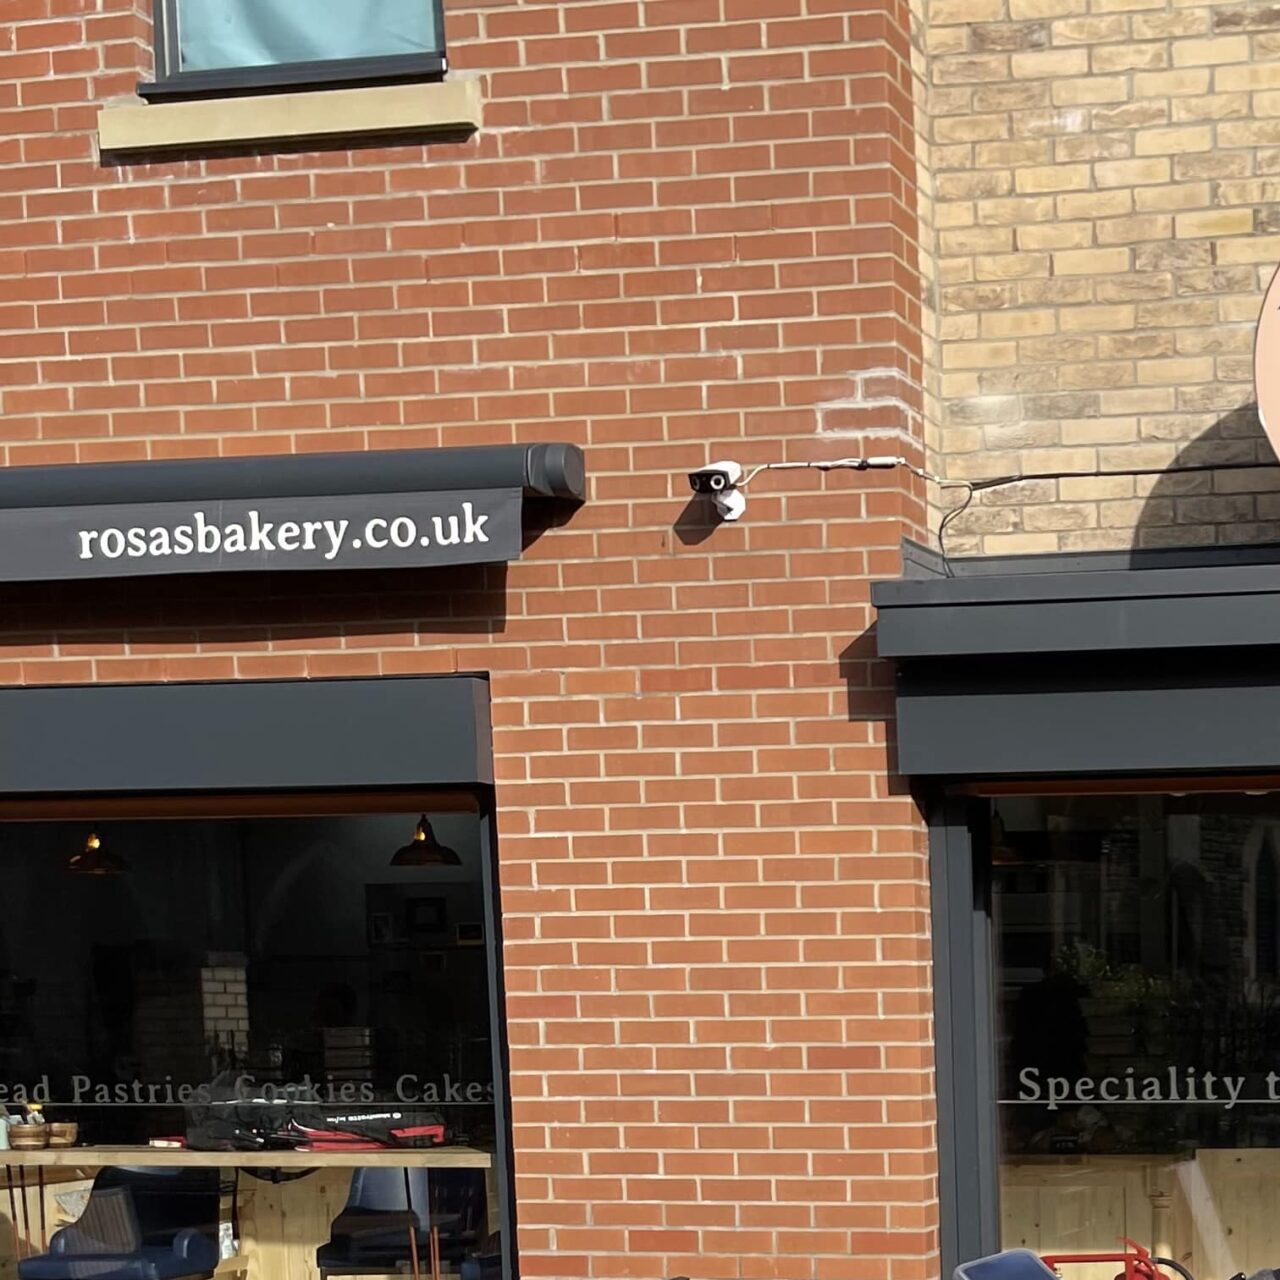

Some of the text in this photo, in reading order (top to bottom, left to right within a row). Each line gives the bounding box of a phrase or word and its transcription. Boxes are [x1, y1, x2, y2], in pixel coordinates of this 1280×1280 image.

[78, 502, 490, 560] rosasbakery.co.uk
[72, 1075, 211, 1103] Pastries
[234, 1074, 375, 1103] Cookies
[1018, 1066, 1246, 1110] Speciality
